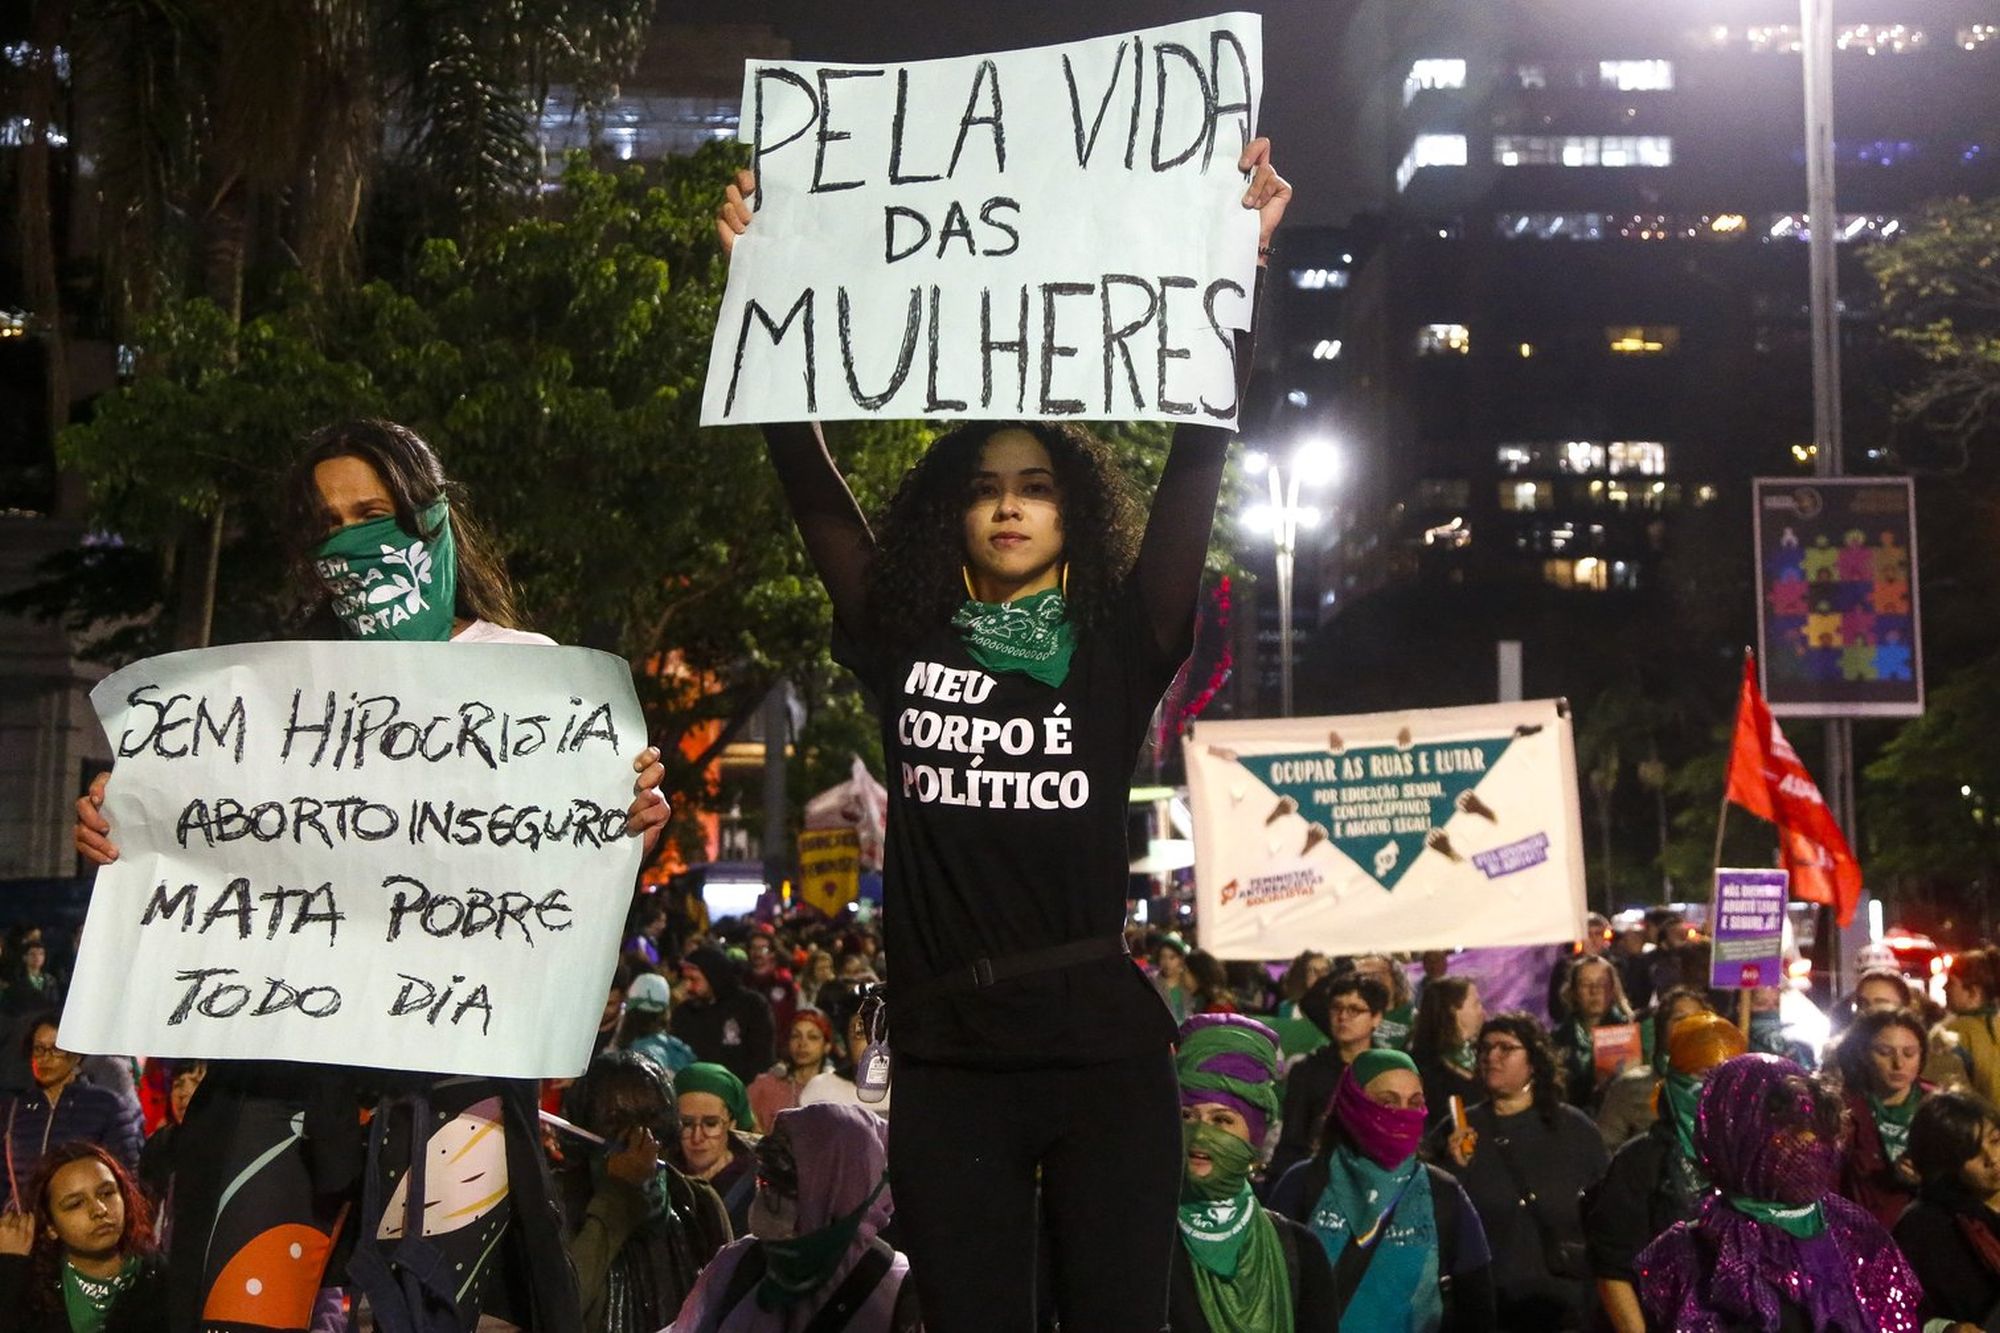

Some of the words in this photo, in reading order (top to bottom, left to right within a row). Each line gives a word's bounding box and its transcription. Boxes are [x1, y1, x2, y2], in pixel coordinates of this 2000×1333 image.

[753, 60, 1004, 212] PELA
[1062, 29, 1251, 182] VIDA
[884, 196, 1020, 264] DAS
[723, 273, 1246, 420] MULHERES
[904, 661, 998, 705] MEU
[117, 684, 247, 764] SEM
[899, 707, 1035, 756] CORPO
[1042, 701, 1073, 755] É
[902, 754, 1090, 810] POLÍTICO
[1270, 758, 1337, 785] OCUPAR
[1342, 757, 1364, 781] AS
[1370, 752, 1415, 778] RUAS
[1418, 751, 1431, 775] E
[1434, 747, 1486, 774] LUTAR
[1313, 788, 1338, 805] POR
[1340, 783, 1400, 804] EDUCAÇÃO
[176, 795, 399, 850] ABORTO
[408, 798, 628, 853] INSEGURO
[1331, 799, 1431, 820] CONTRACEPTIVOS
[1346, 818, 1392, 837] ABORTO
[140, 877, 346, 947] MATA
[381, 874, 573, 949] POBRE
[167, 968, 342, 1026] TODO
[389, 973, 494, 1036] DIA
